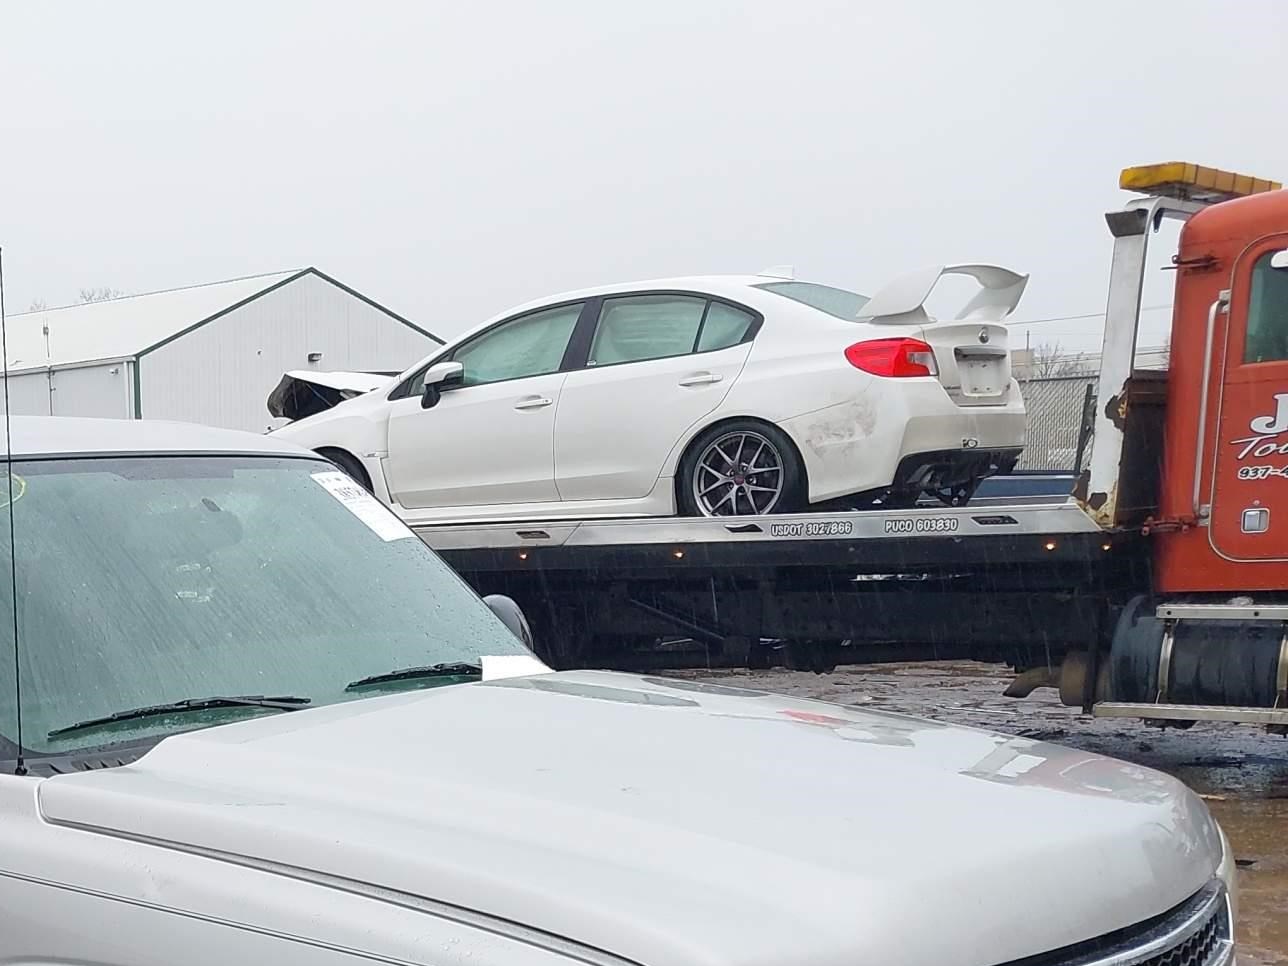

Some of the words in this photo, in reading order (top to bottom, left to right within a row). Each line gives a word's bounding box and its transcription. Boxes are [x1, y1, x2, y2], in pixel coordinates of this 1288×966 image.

[771, 523, 803, 537] USDOT
[805, 522, 853, 535] 3027866
[885, 519, 914, 533] PUCO
[916, 518, 959, 532] 603830
